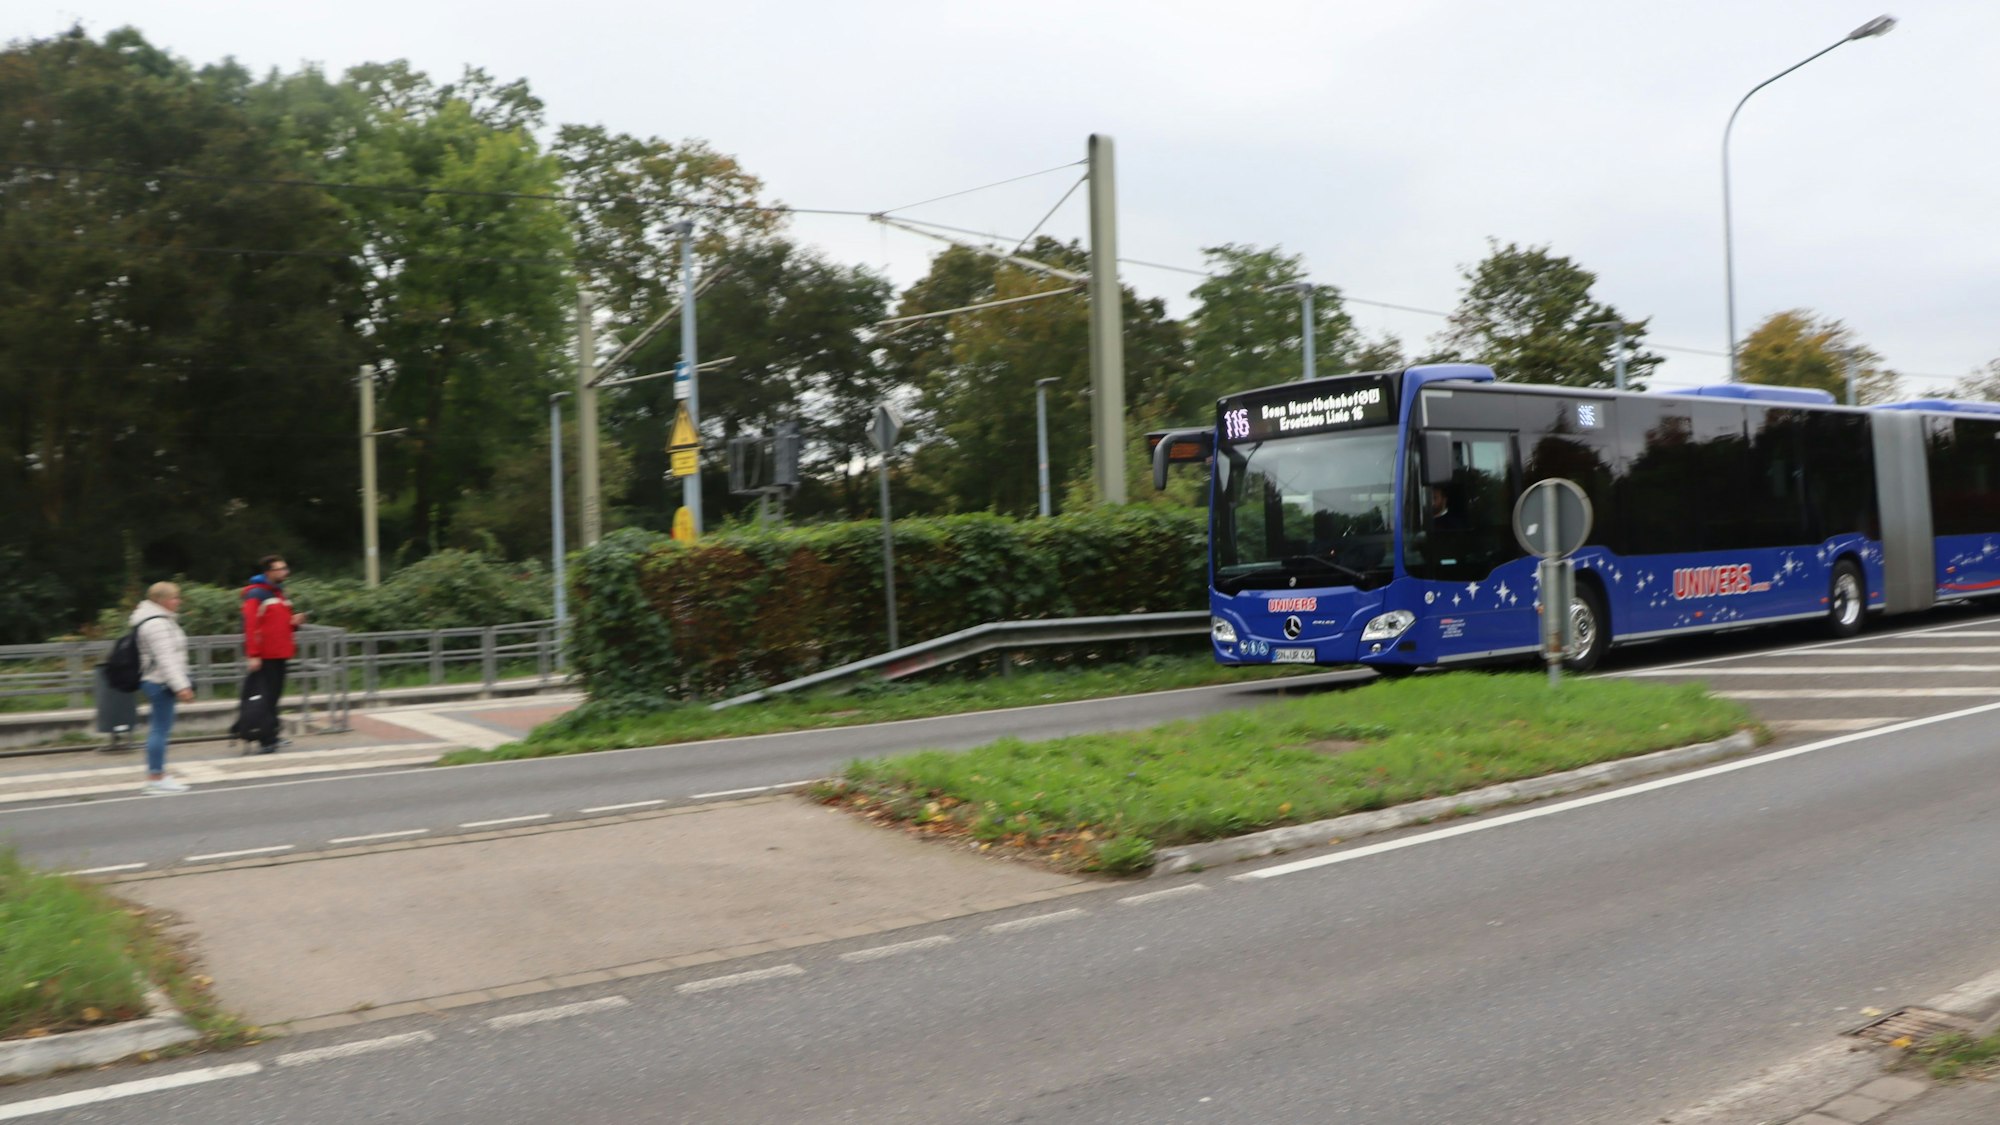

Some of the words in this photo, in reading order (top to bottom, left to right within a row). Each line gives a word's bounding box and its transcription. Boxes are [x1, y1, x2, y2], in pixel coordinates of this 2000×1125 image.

[1262, 405, 1286, 419] Bonn
[1288, 391, 1359, 416] Hauptbahnhof
[1280, 413, 1325, 431] Ersatzbus
[1326, 409, 1350, 424] Linie
[1351, 406, 1364, 421] 16
[1224, 409, 1250, 439] 116
[1673, 563, 1751, 600] UNIVERS
[1268, 597, 1317, 612] UNIVERS
